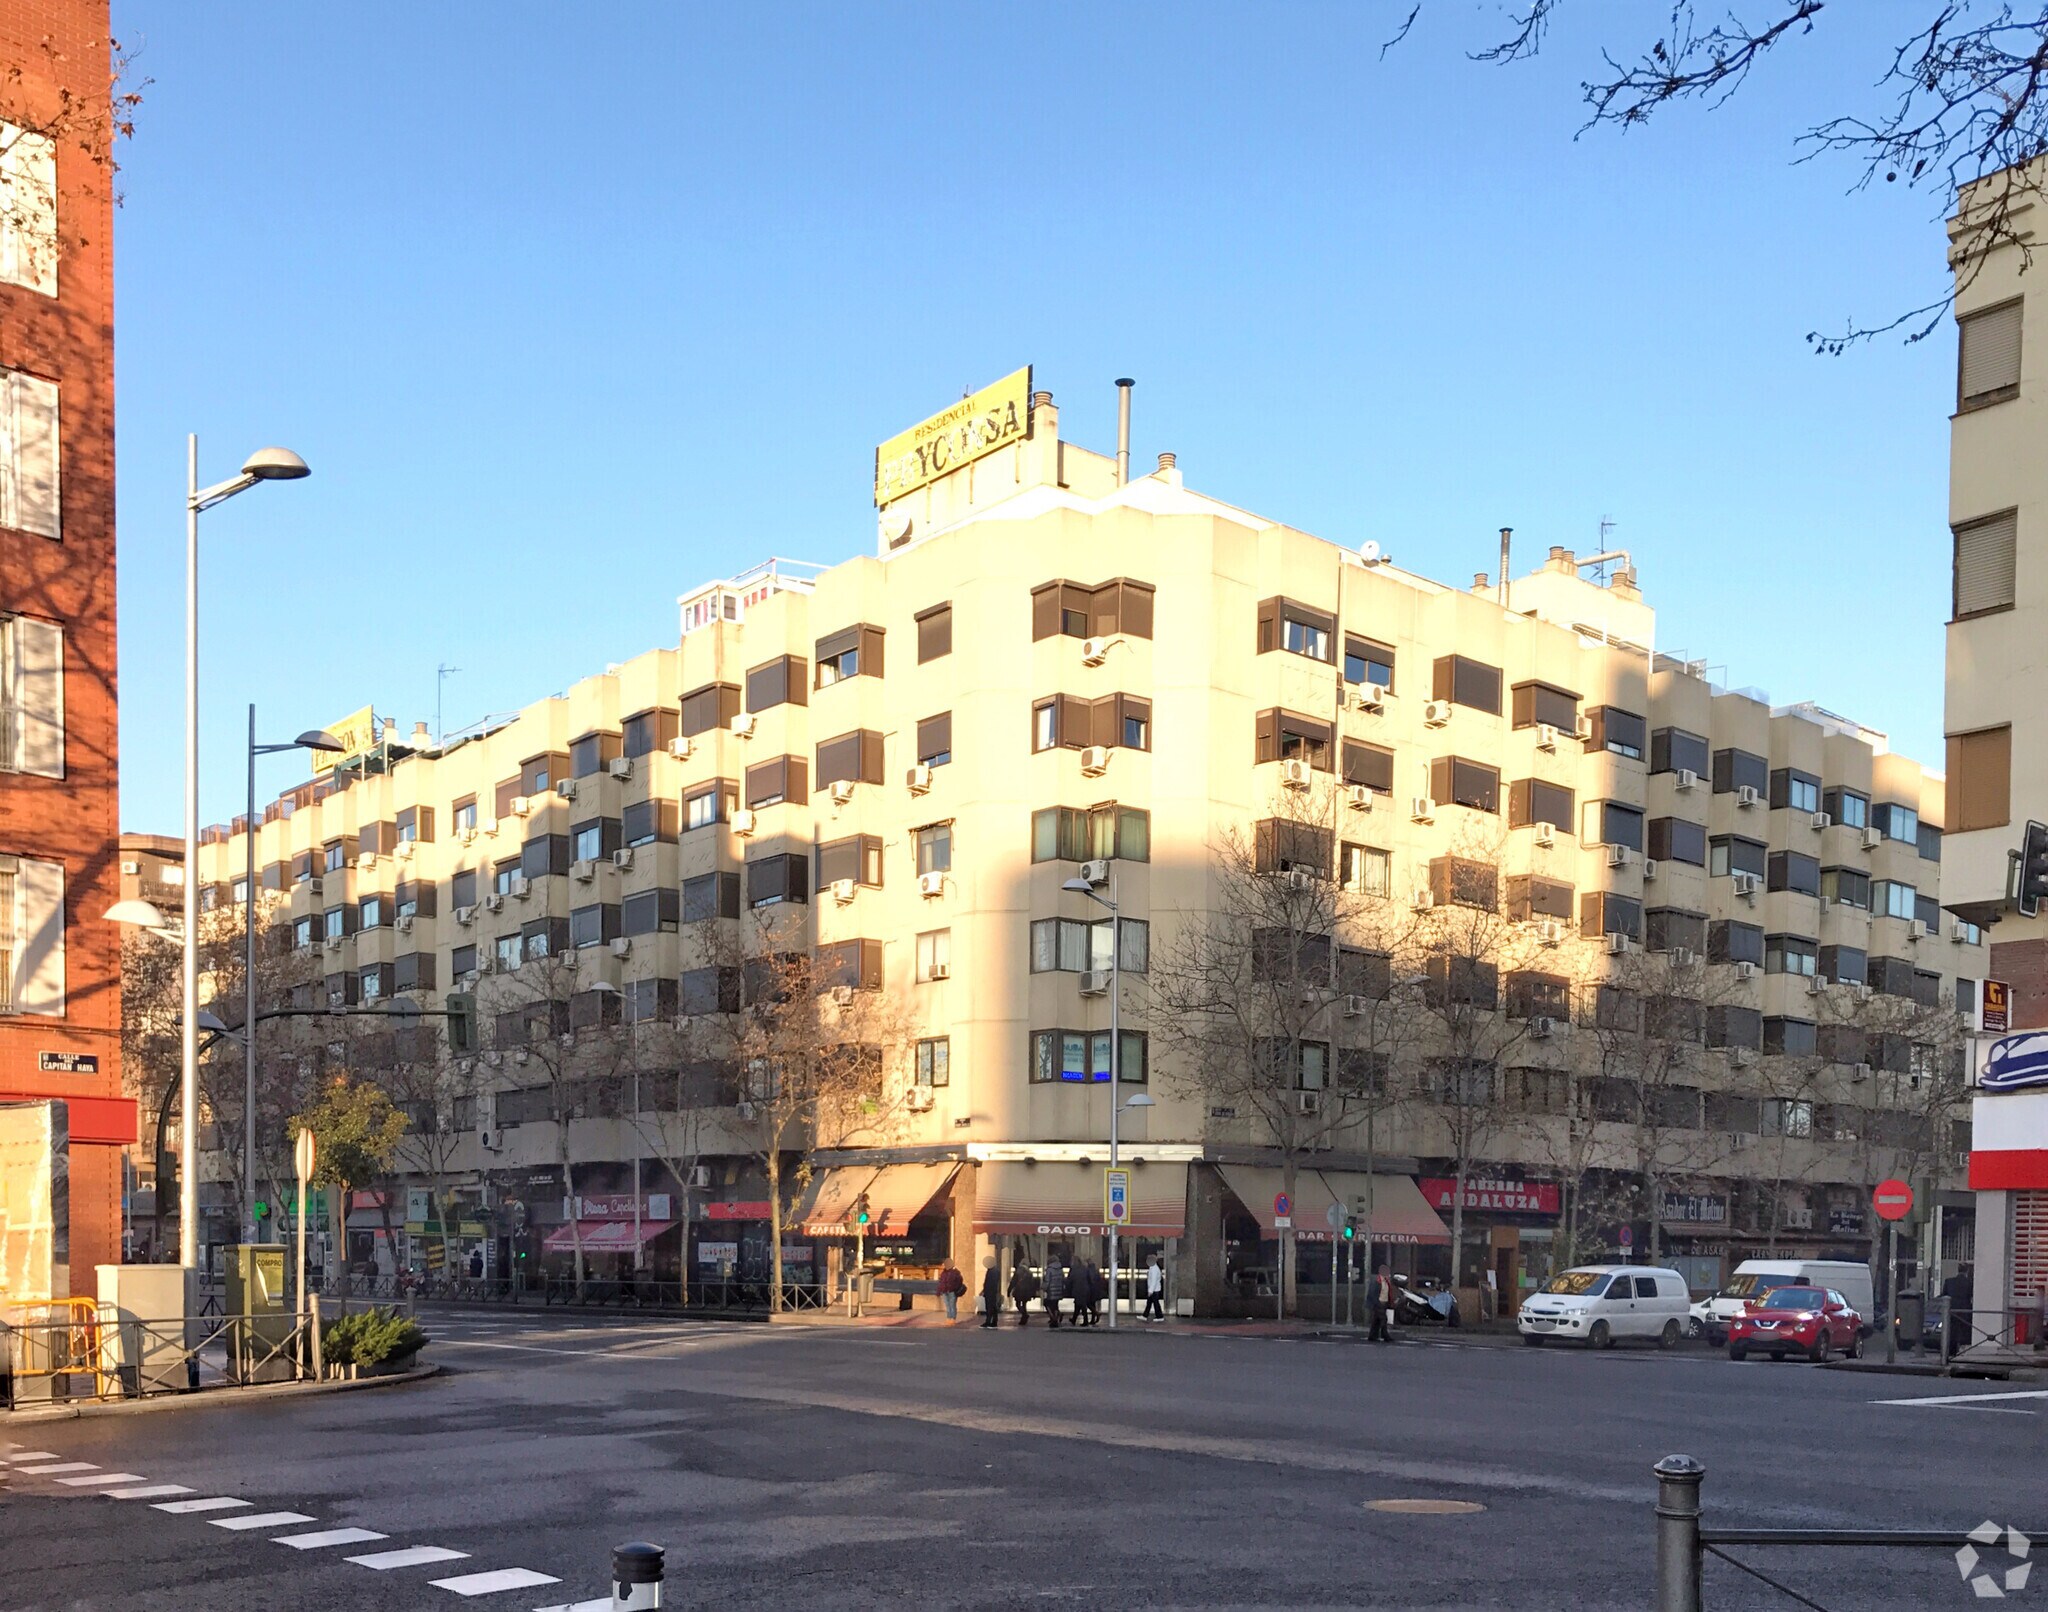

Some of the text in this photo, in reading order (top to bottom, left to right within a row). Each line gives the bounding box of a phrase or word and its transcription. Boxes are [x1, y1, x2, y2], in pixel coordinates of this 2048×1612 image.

[77, 1064, 94, 1072] HAYA
[1457, 1178, 1525, 1192] ABERNA
[1037, 1225, 1091, 1235] GAGO
[1298, 1231, 1419, 1243] BAR CRECERIA
[257, 1259, 282, 1267] COMPRO
